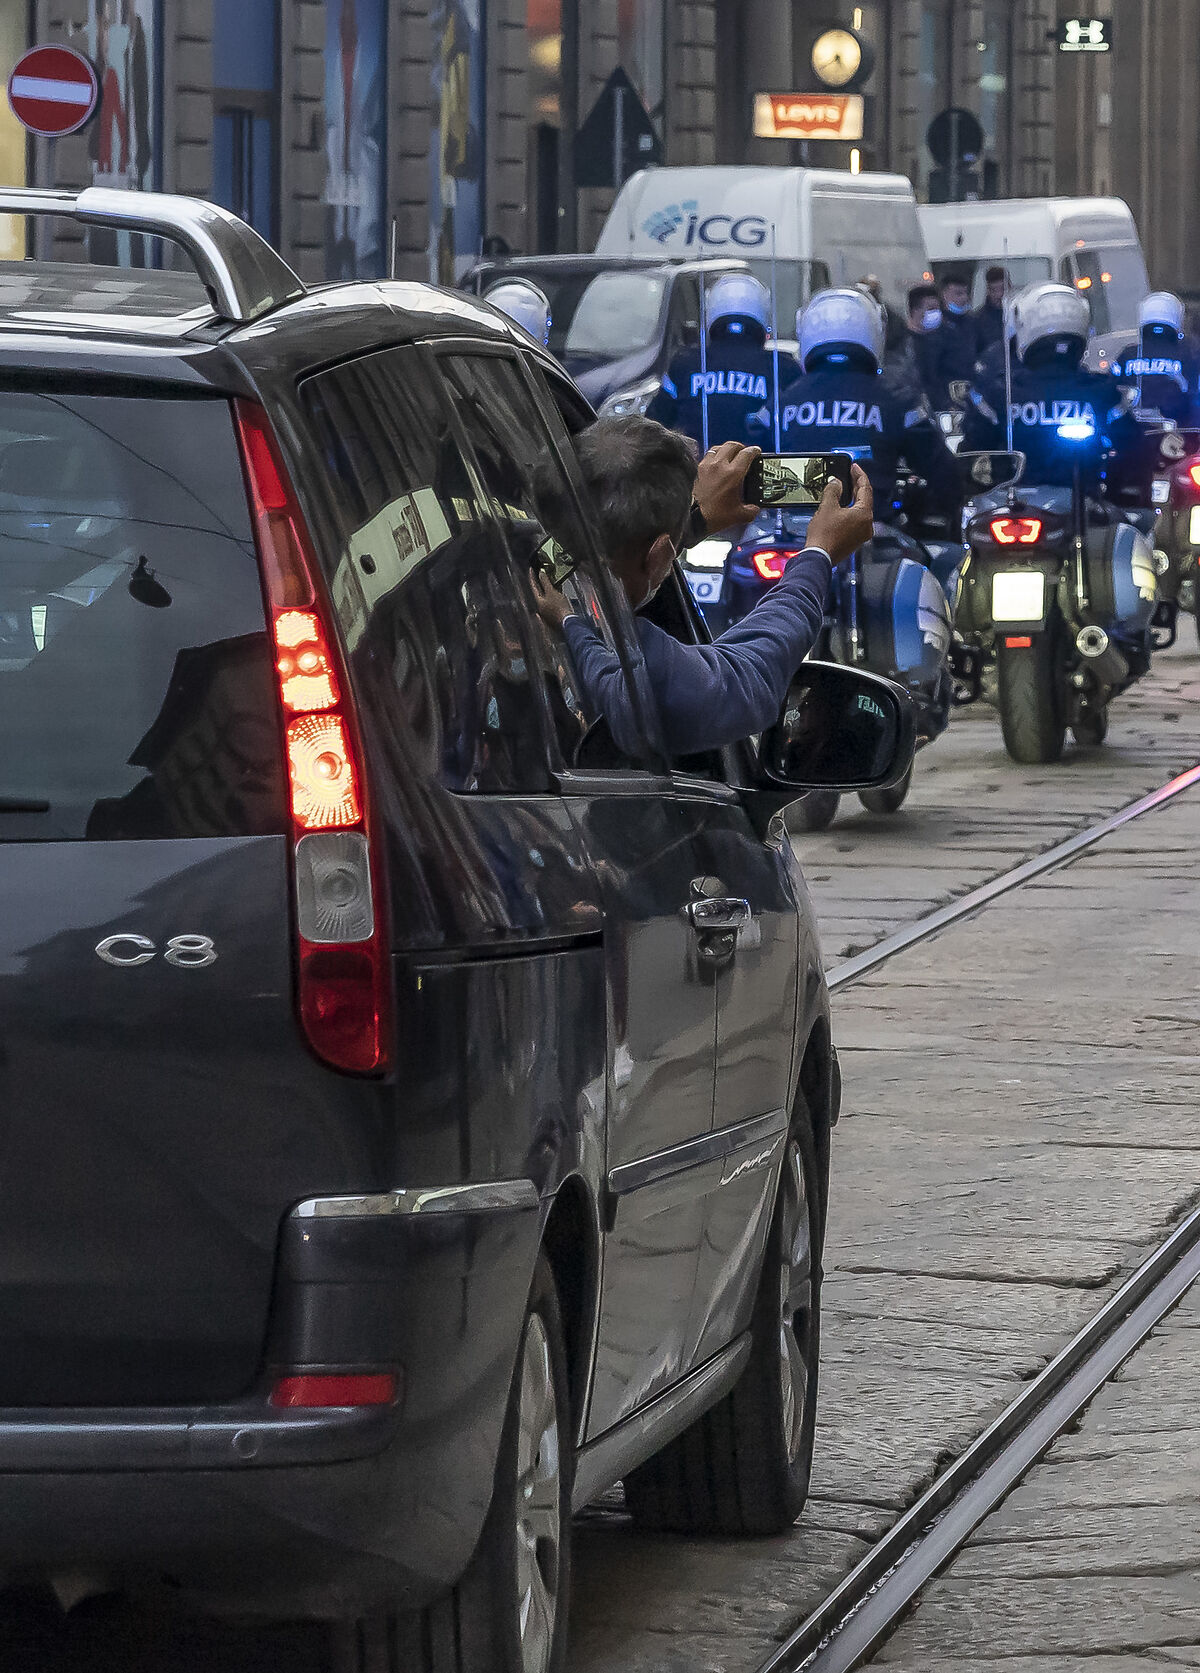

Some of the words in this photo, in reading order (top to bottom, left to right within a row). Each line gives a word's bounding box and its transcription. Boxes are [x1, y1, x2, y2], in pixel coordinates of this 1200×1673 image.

[690, 370, 768, 399] POLIZIA
[782, 400, 884, 432] POLIZIA
[1009, 400, 1096, 426] POLIZIA
[95, 933, 218, 968] C8
